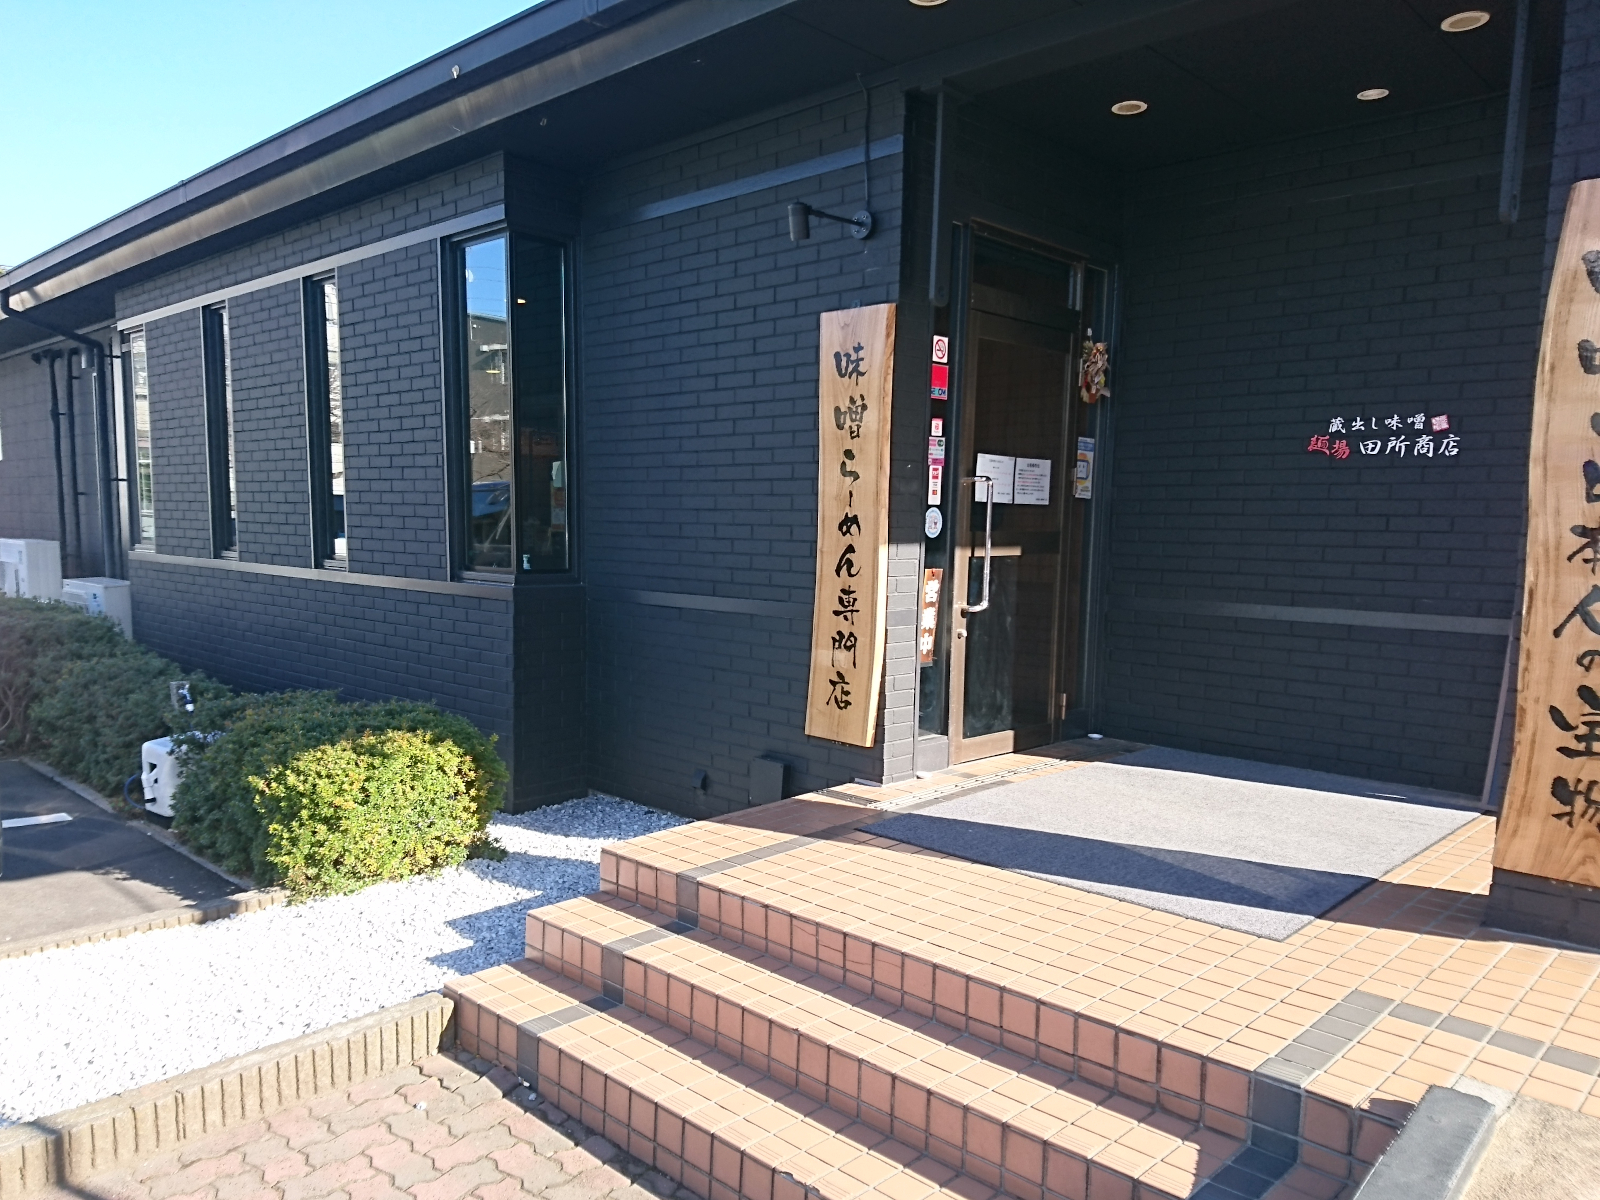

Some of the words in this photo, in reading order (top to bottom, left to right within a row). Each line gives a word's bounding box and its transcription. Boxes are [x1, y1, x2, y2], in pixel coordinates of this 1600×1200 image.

[1328, 412, 1426, 434] 蔵出し味噌
[1359, 433, 1462, 459] 田所商店
[827, 342, 870, 712] 味噌らーめん専門店
[919, 579, 940, 655] 営業中
